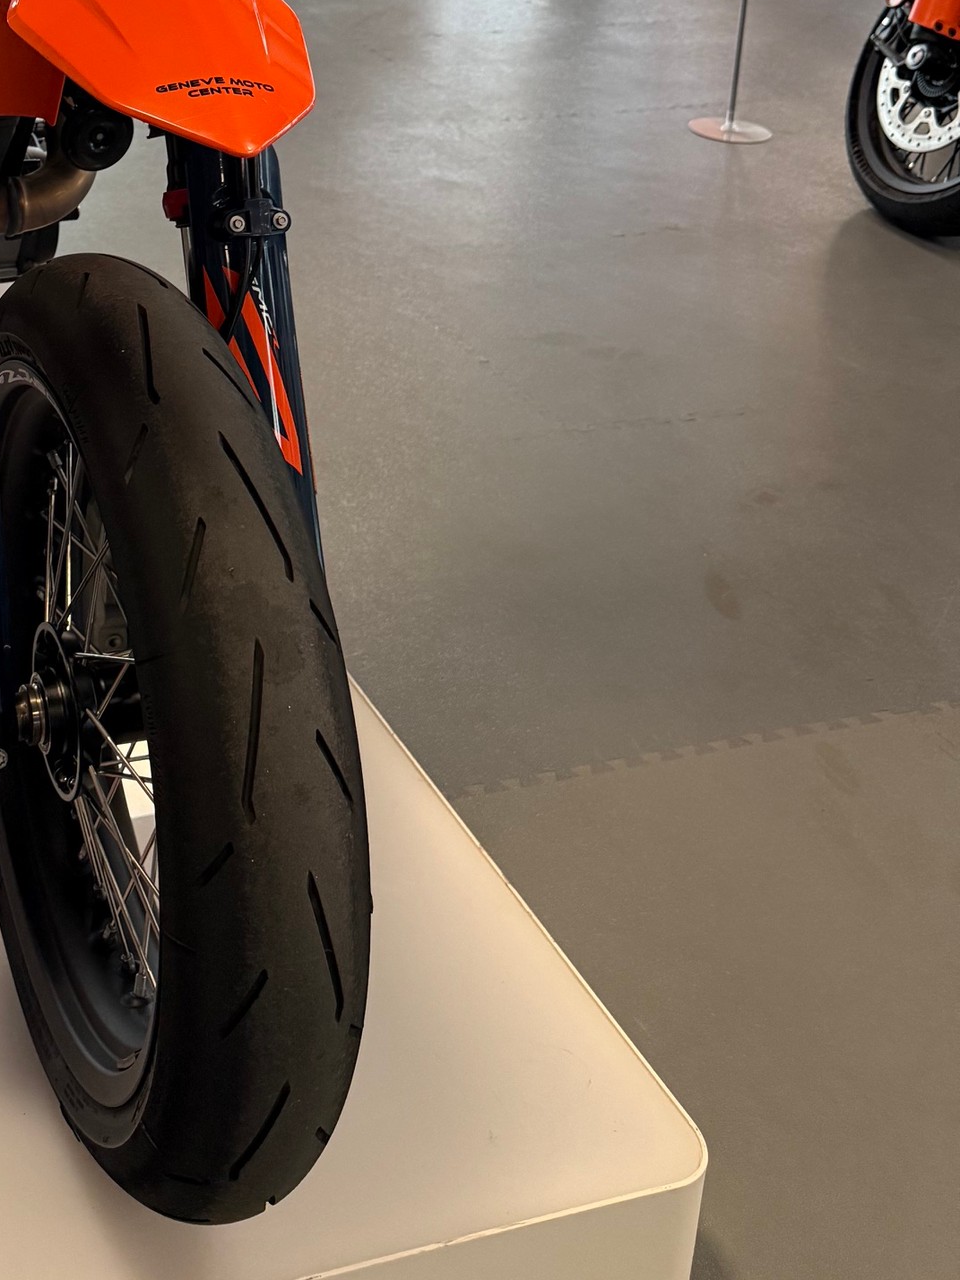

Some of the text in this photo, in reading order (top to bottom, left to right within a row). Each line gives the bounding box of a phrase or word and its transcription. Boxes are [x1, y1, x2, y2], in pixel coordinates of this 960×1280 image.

[155, 76, 275, 94] GENEVE MOTO
[187, 86, 255, 98] CENTER
